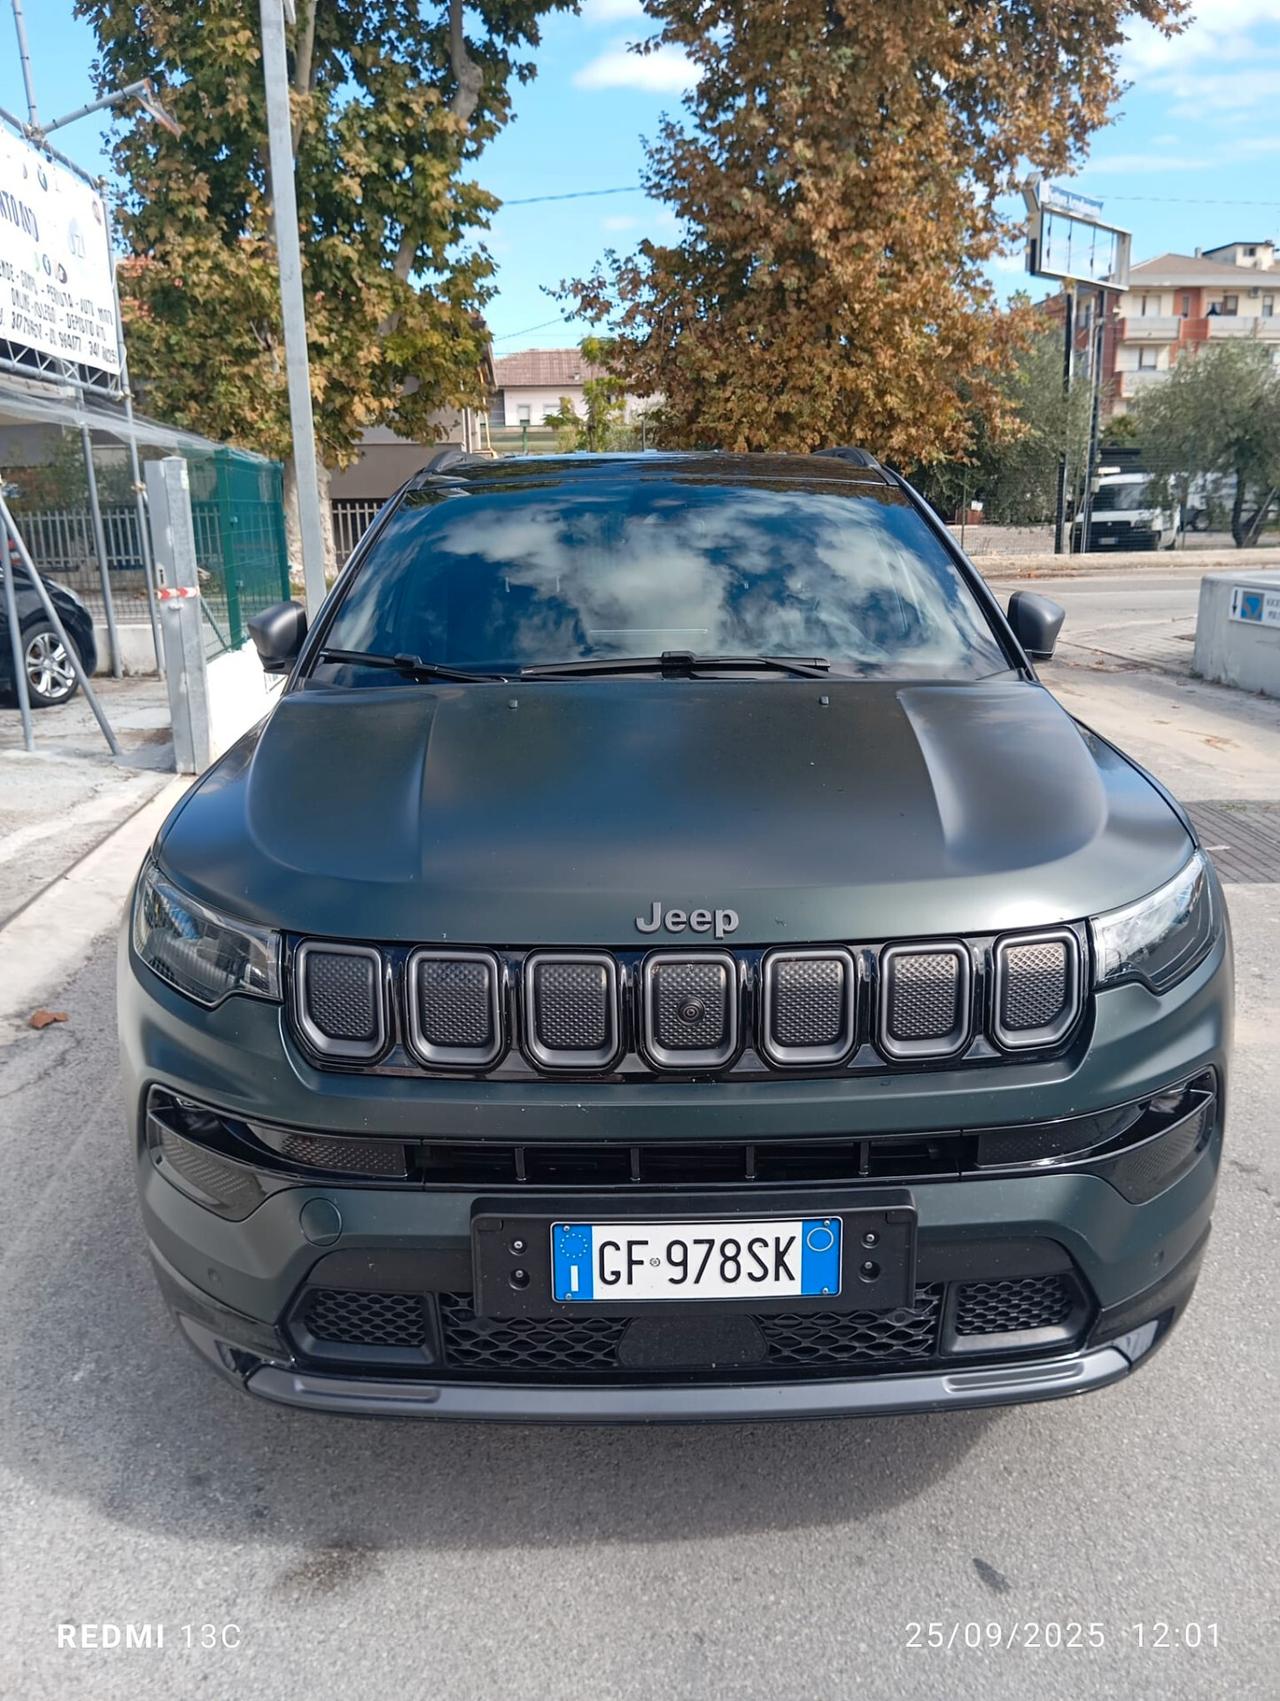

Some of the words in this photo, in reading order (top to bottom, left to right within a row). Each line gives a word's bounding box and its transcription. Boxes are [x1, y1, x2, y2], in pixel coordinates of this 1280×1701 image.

[635, 902, 740, 940] Jeep
[598, 1240, 649, 1286] GF
[666, 1236, 797, 1285] 978SK
